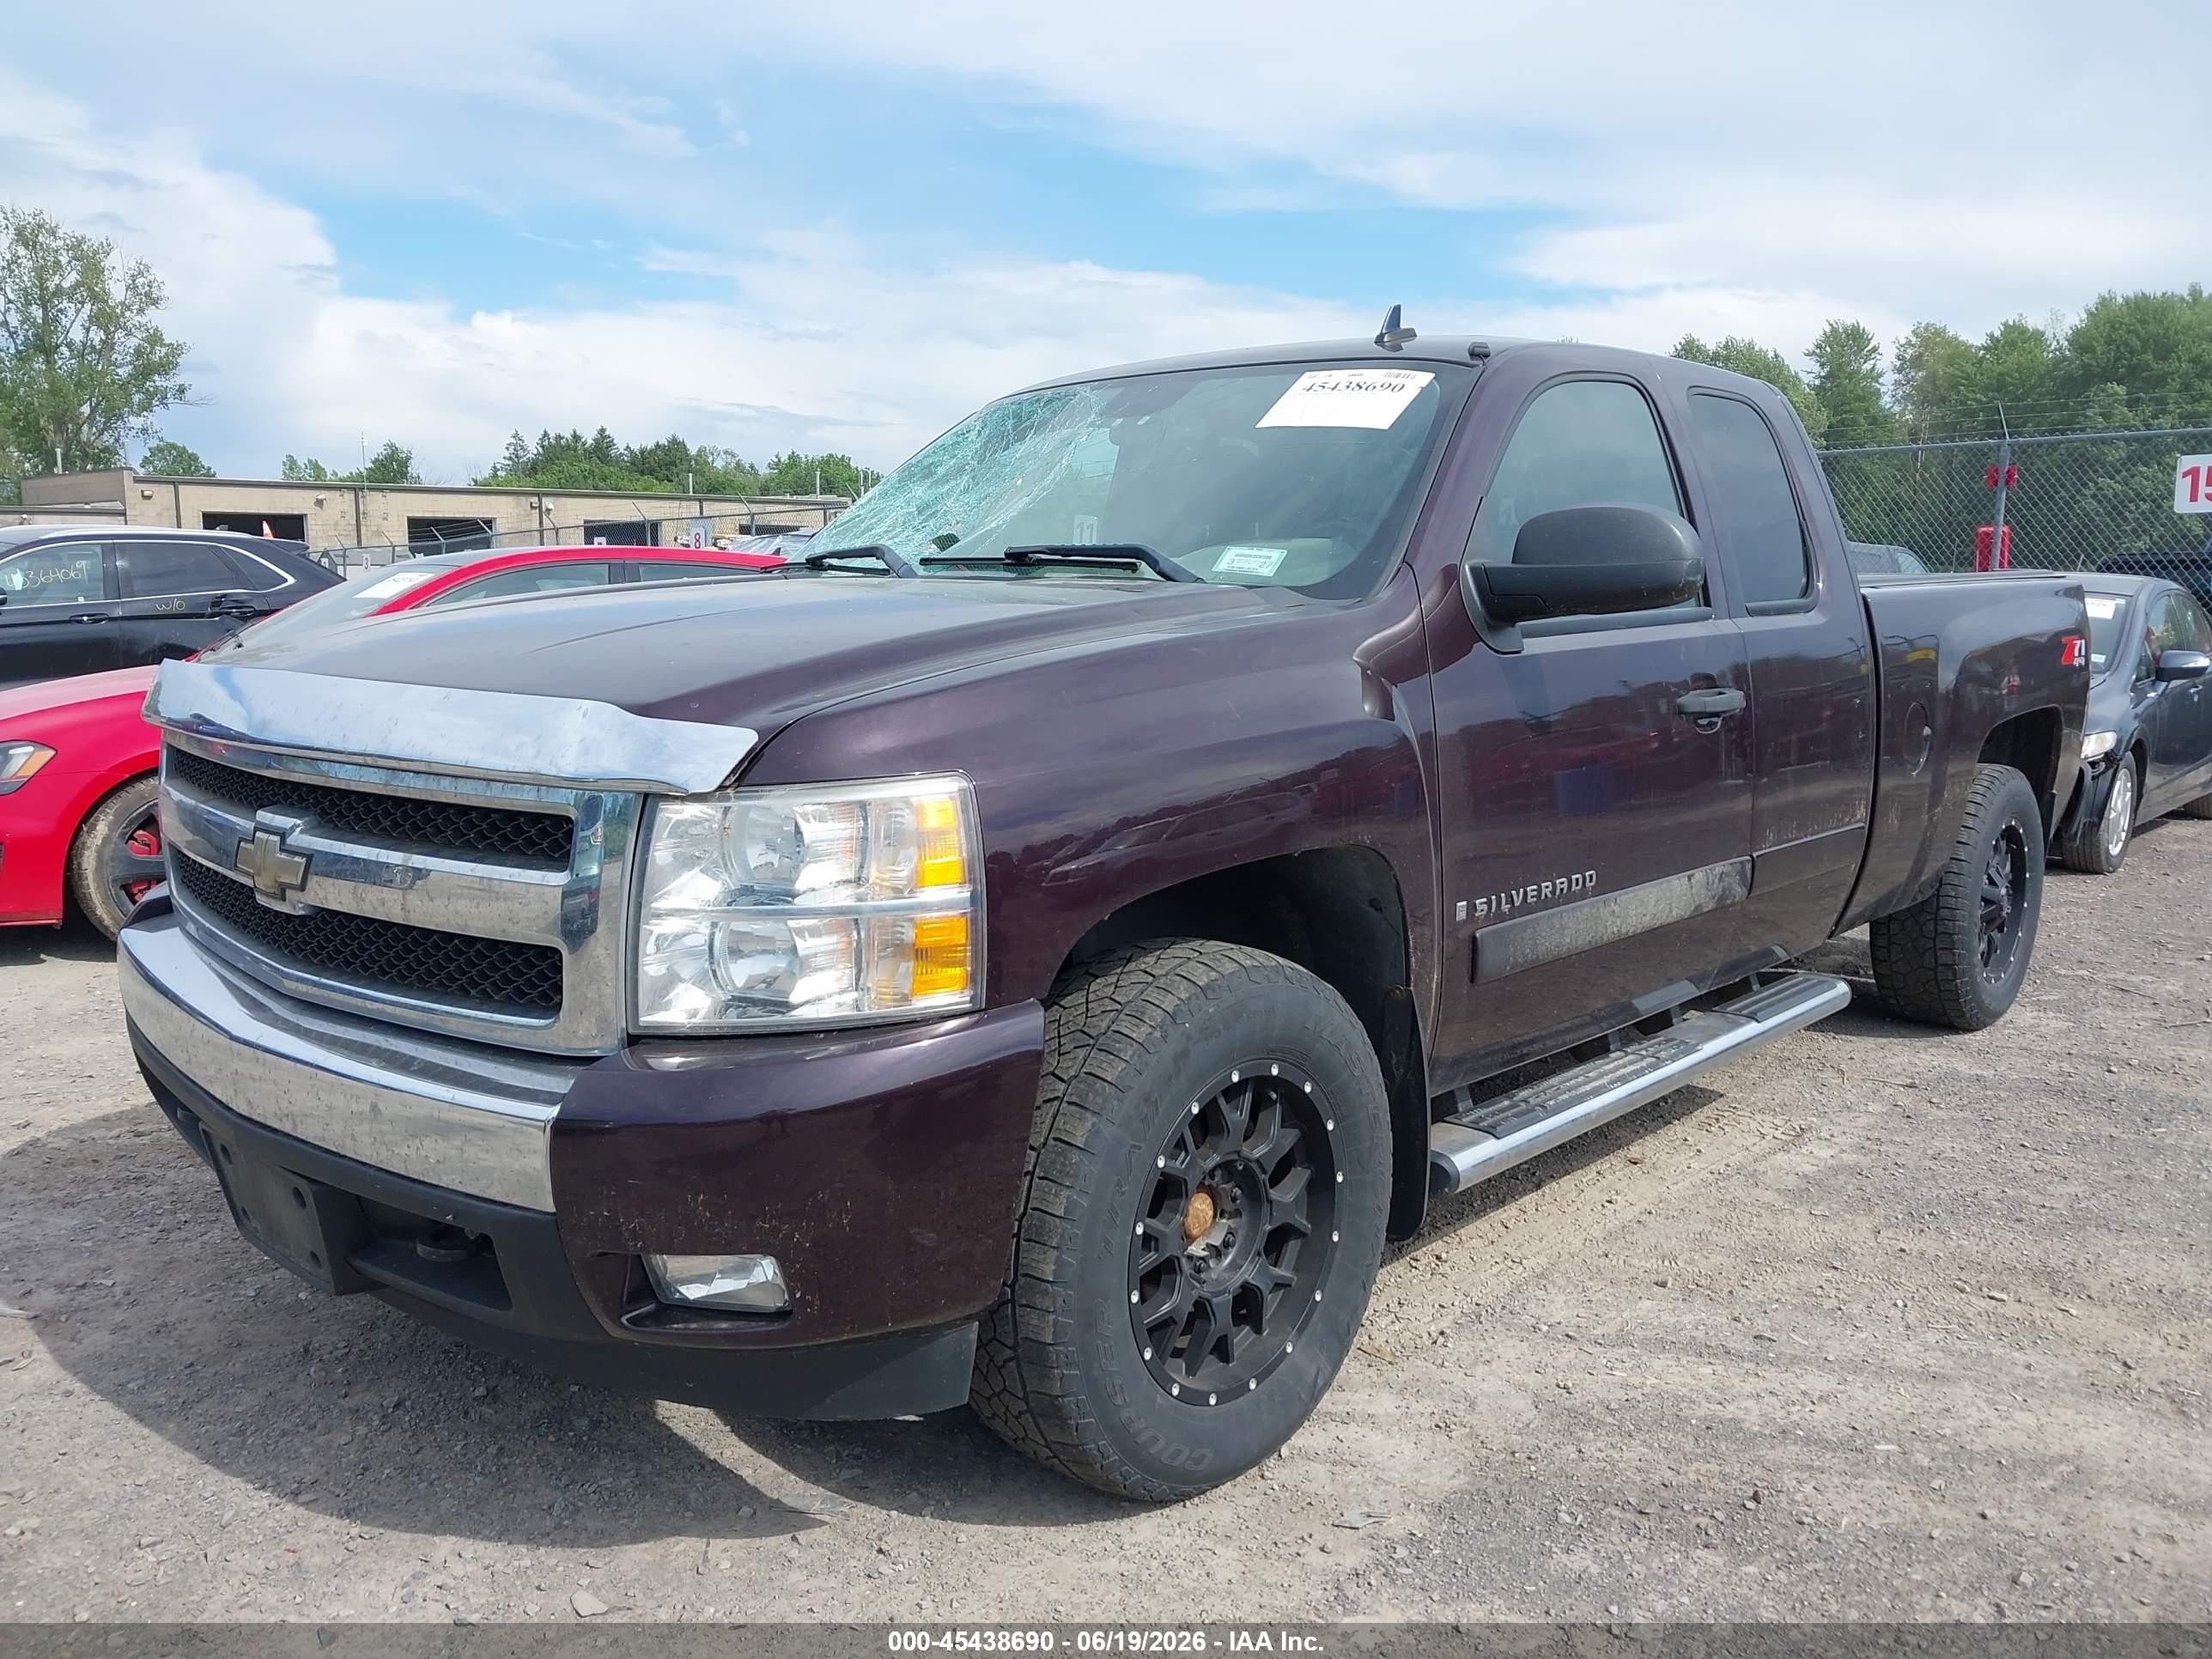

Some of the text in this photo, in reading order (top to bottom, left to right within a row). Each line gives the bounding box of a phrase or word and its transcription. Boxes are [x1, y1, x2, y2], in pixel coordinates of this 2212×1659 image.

[1301, 381, 1406, 392] 45438690
[694, 532, 702, 550] 8
[364, 556, 369, 570] 3
[1474, 870, 1597, 917] SILVERADO
[1094, 1297, 1215, 1471] COURSER
